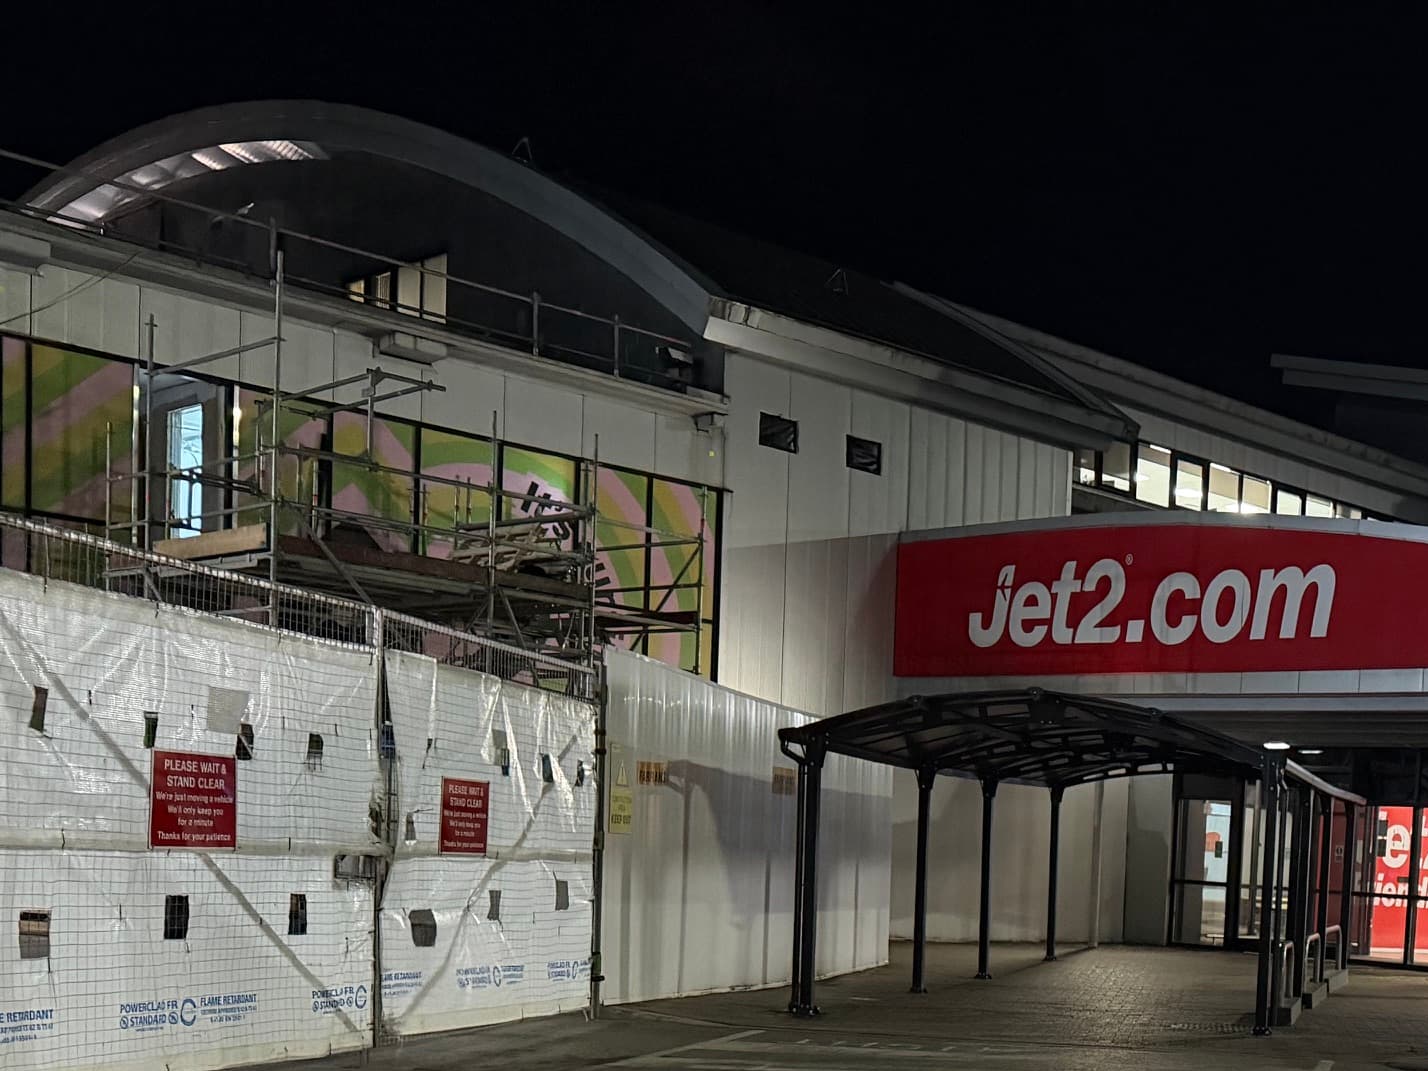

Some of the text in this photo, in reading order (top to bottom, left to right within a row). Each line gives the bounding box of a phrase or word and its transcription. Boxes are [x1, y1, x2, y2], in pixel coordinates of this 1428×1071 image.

[968, 558, 1337, 648] Jet2.com
[164, 759, 227, 774] PLEASE WAIT &
[166, 775, 225, 790] STAND CLEAR
[157, 830, 180, 840] Thanks
[167, 1000, 178, 1010] FR
[200, 996, 222, 1007] FLAME
